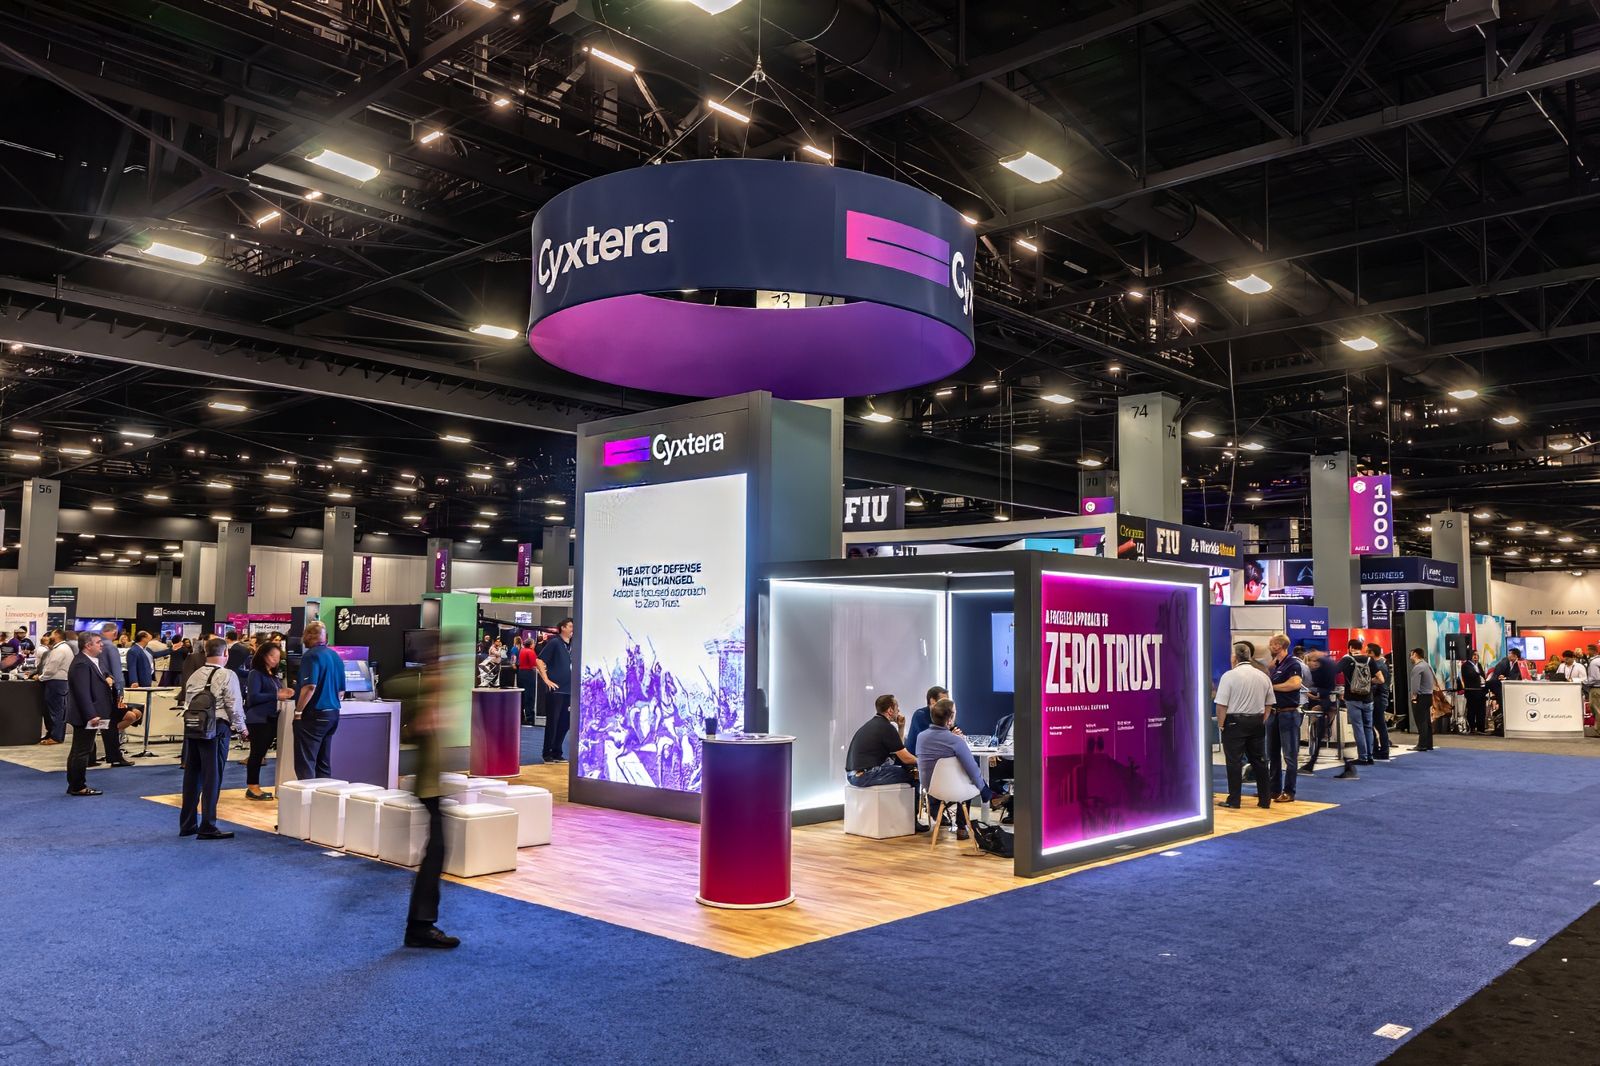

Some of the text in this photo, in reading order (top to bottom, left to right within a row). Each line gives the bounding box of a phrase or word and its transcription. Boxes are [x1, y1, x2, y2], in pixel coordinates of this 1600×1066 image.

[538, 220, 669, 293] Cyxtera
[1131, 404, 1148, 419] 74
[1167, 424, 1176, 439] 74
[652, 432, 724, 466] Cyxtera
[845, 495, 889, 524] FIU
[1373, 484, 1389, 550] 1000
[1439, 519, 1454, 529] 76
[1156, 527, 1181, 555] FIU
[617, 566, 634, 577] THE
[651, 564, 663, 575] OF
[663, 562, 702, 574] DEFENSE
[1045, 631, 1163, 694] ZERO TRUST
